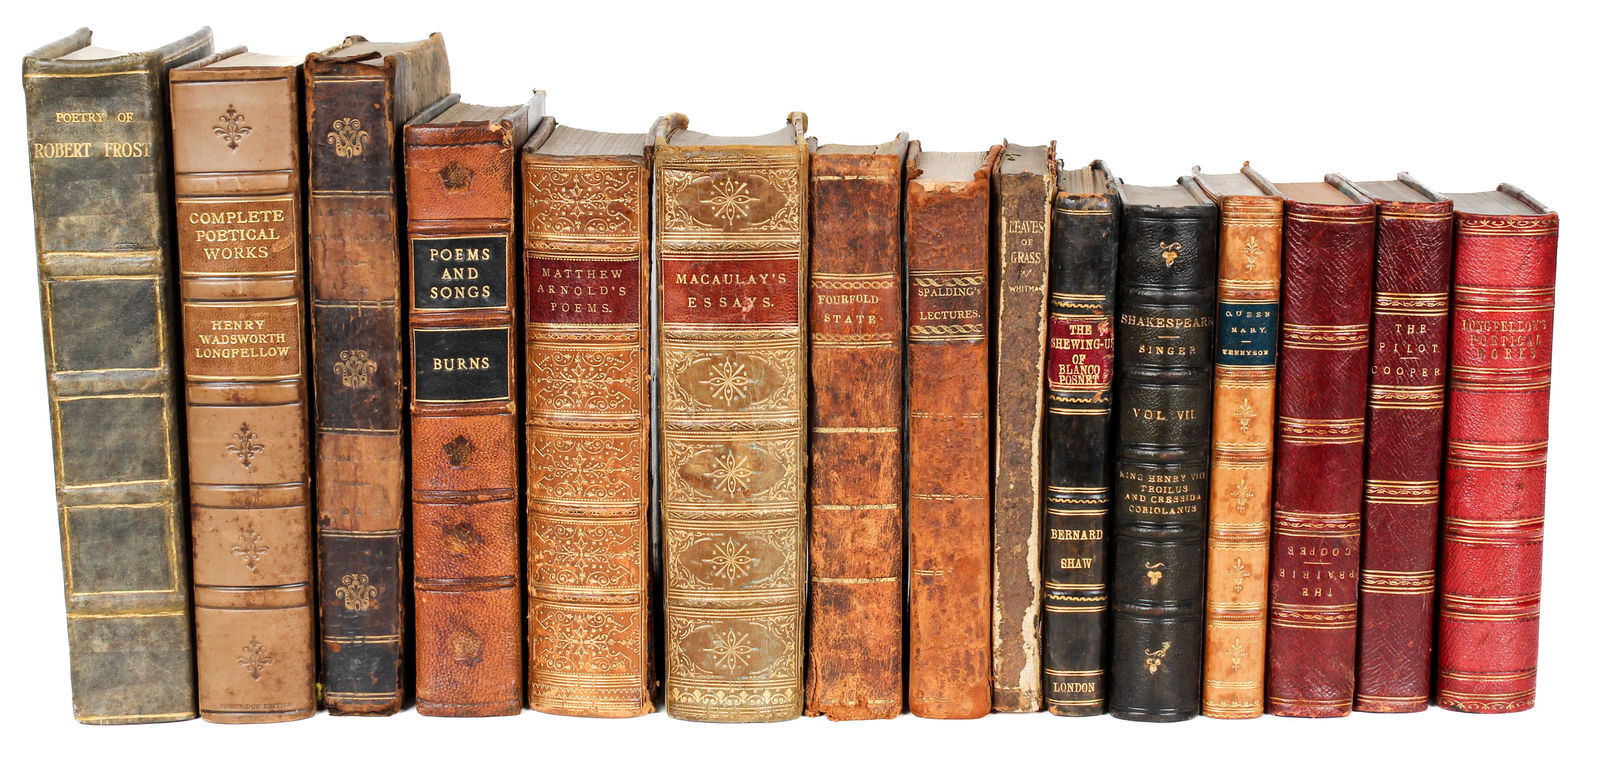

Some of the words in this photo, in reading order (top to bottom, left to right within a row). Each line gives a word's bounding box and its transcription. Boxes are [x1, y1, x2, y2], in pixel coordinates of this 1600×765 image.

[55, 112, 105, 123] POETRY
[117, 112, 134, 122] OF
[34, 142, 92, 159] ROBERT
[104, 142, 152, 158] FROST
[189, 209, 285, 225] COMPLETE
[1009, 220, 1044, 234] LEAVES
[195, 228, 281, 242] POETICAL
[1020, 238, 1033, 246] OF
[203, 246, 270, 260] WORKS
[430, 248, 490, 262] POEMS
[1010, 251, 1041, 264] GRASS
[441, 267, 479, 281] AND
[541, 267, 623, 279] MATTHEW
[675, 273, 787, 285] MACAULAY'S
[430, 285, 491, 299] SONGS
[537, 284, 627, 297] ARNOLD'S
[687, 296, 775, 309] ESSAYS.
[817, 294, 880, 305] FOURFOLD
[550, 302, 613, 313] POEMS.
[824, 313, 877, 325] STATE
[919, 310, 981, 321] LECTURES.
[1225, 310, 1271, 318] QUEEN
[211, 320, 265, 331] HENRY
[1069, 324, 1092, 336] THE
[1395, 324, 1427, 334] THE
[198, 334, 287, 345] WADSWORTH
[1469, 335, 1541, 347] POETICAL
[195, 347, 291, 359] LONGFELLOW
[1138, 344, 1197, 356] SINGER
[1379, 342, 1440, 353] PILOT.
[1071, 354, 1086, 365] OF
[1476, 348, 1537, 361] WORKS
[433, 357, 490, 370] BURNS
[1058, 365, 1101, 375] BLANCO
[1058, 375, 1101, 385] POSNET
[1147, 474, 1187, 483] HENRY
[1140, 484, 1190, 494] TROILUS
[1124, 493, 1147, 502] AND
[1150, 494, 1202, 504] CRESSIDA
[1128, 504, 1199, 515] CORIOLANUS
[1050, 529, 1104, 541] BERNARD
[1287, 546, 1352, 557] COOPER
[1060, 558, 1093, 569] SHAW
[1279, 568, 1355, 580] PRAIRIE
[1301, 587, 1334, 597] THE
[1053, 682, 1096, 693] LONDON
